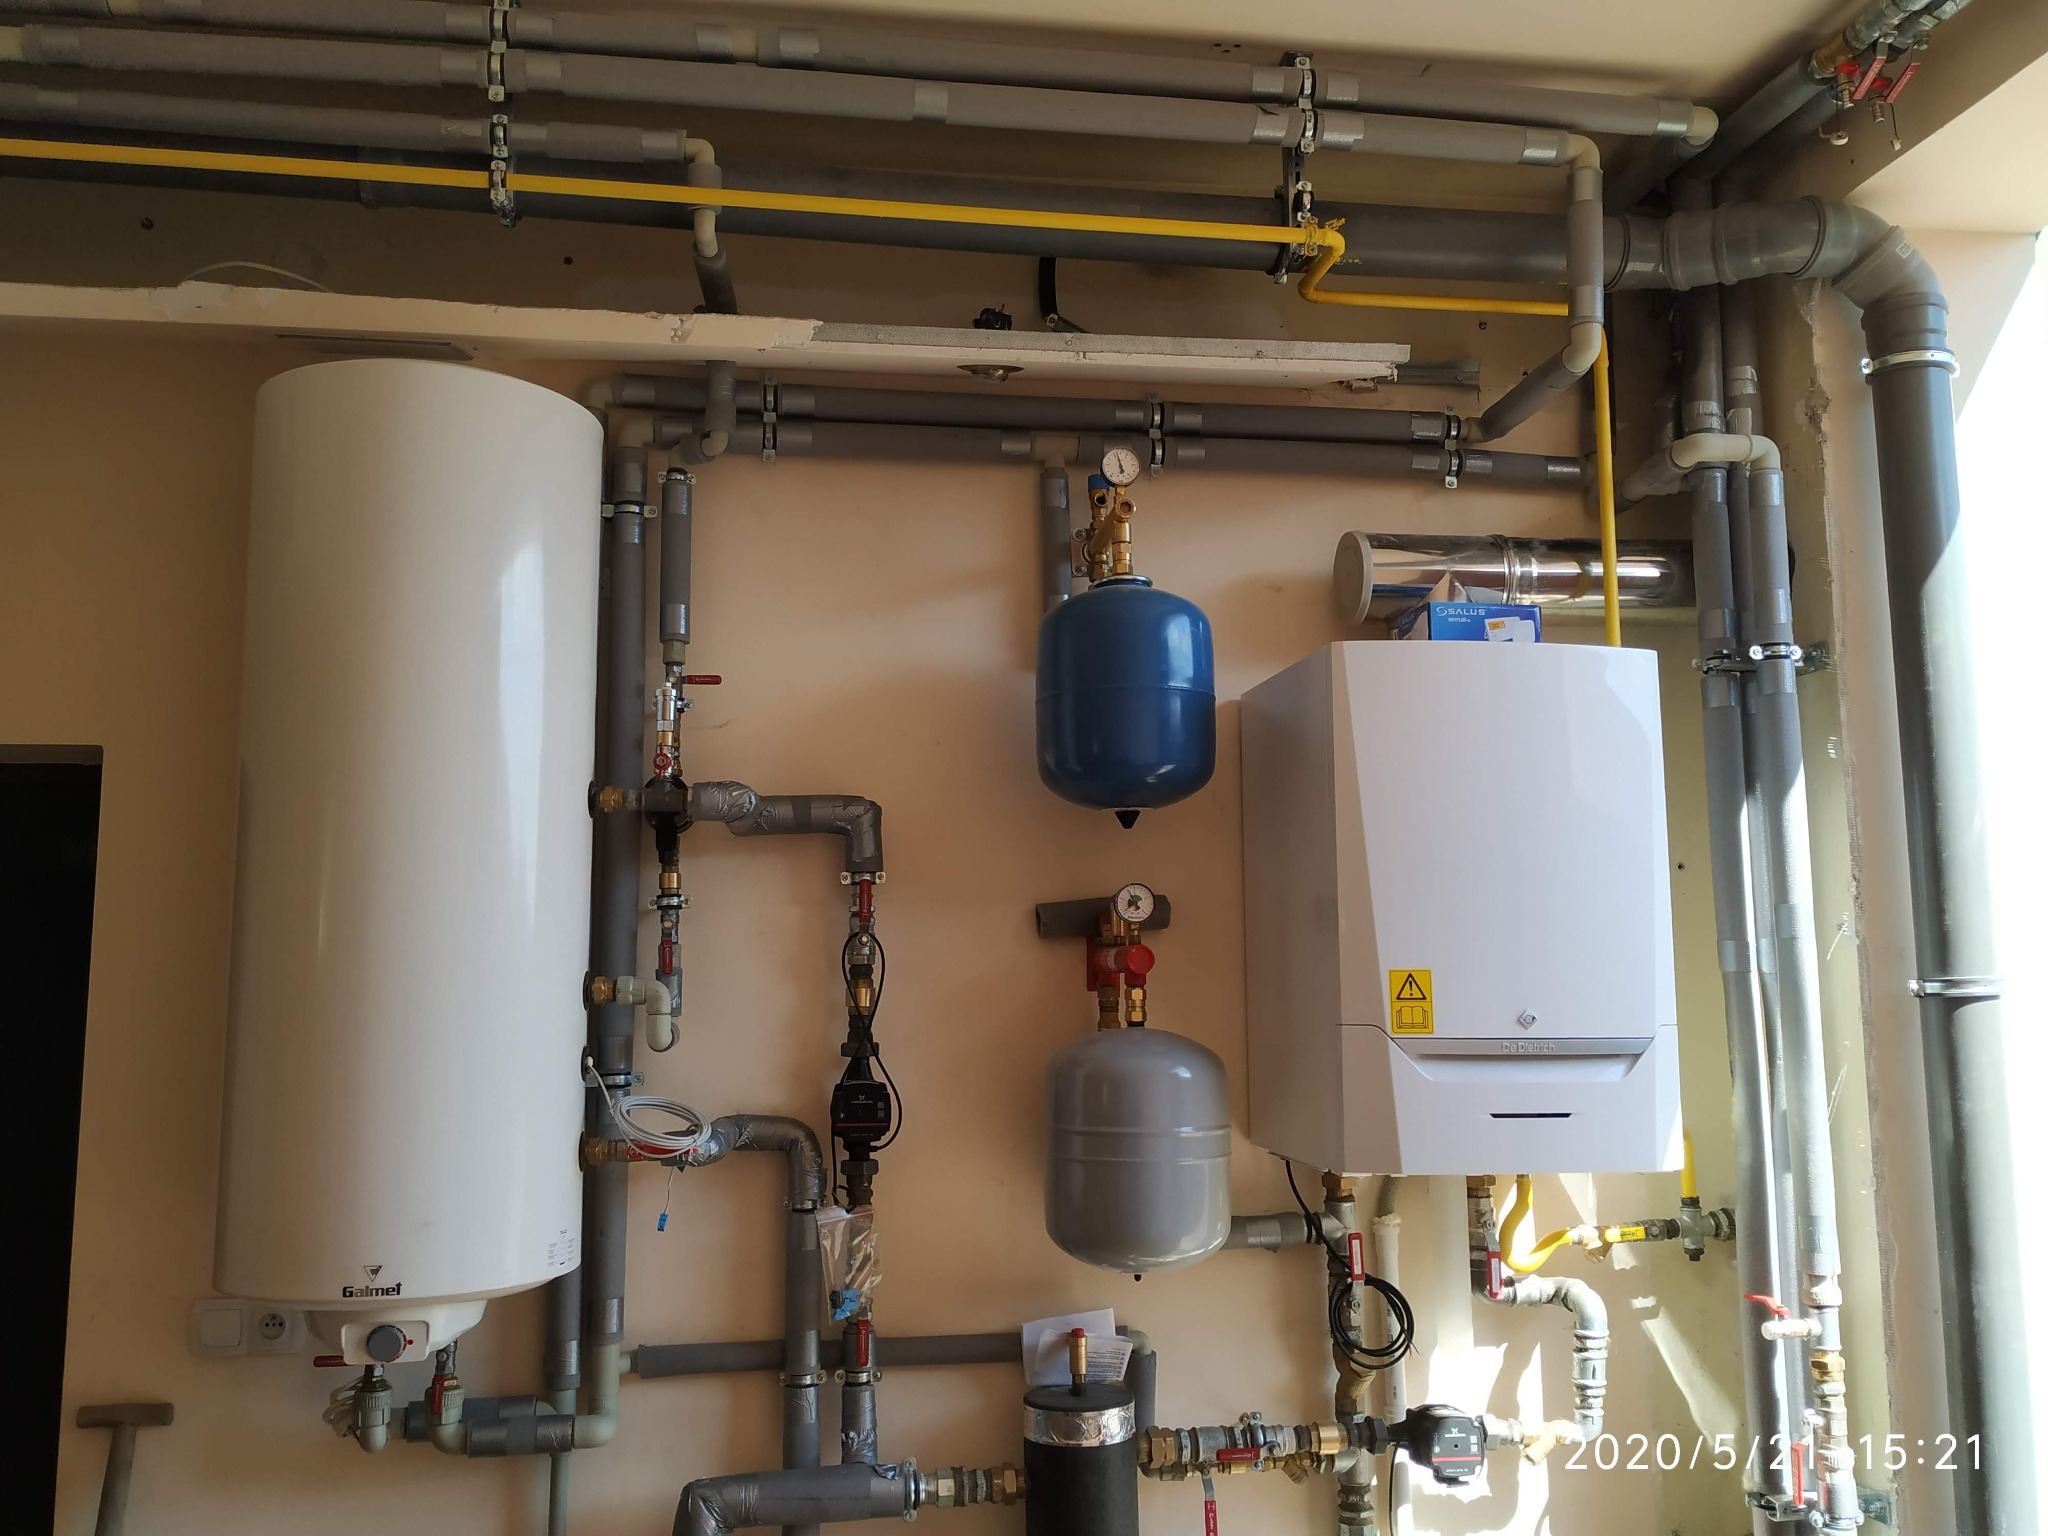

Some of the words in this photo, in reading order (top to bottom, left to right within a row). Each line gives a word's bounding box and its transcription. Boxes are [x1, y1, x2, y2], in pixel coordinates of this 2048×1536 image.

[1448, 608, 1487, 616] SALUS
[1502, 1042, 1517, 1053] De
[1517, 1042, 1556, 1053] Dietrich
[342, 1282, 403, 1298] Galmet
